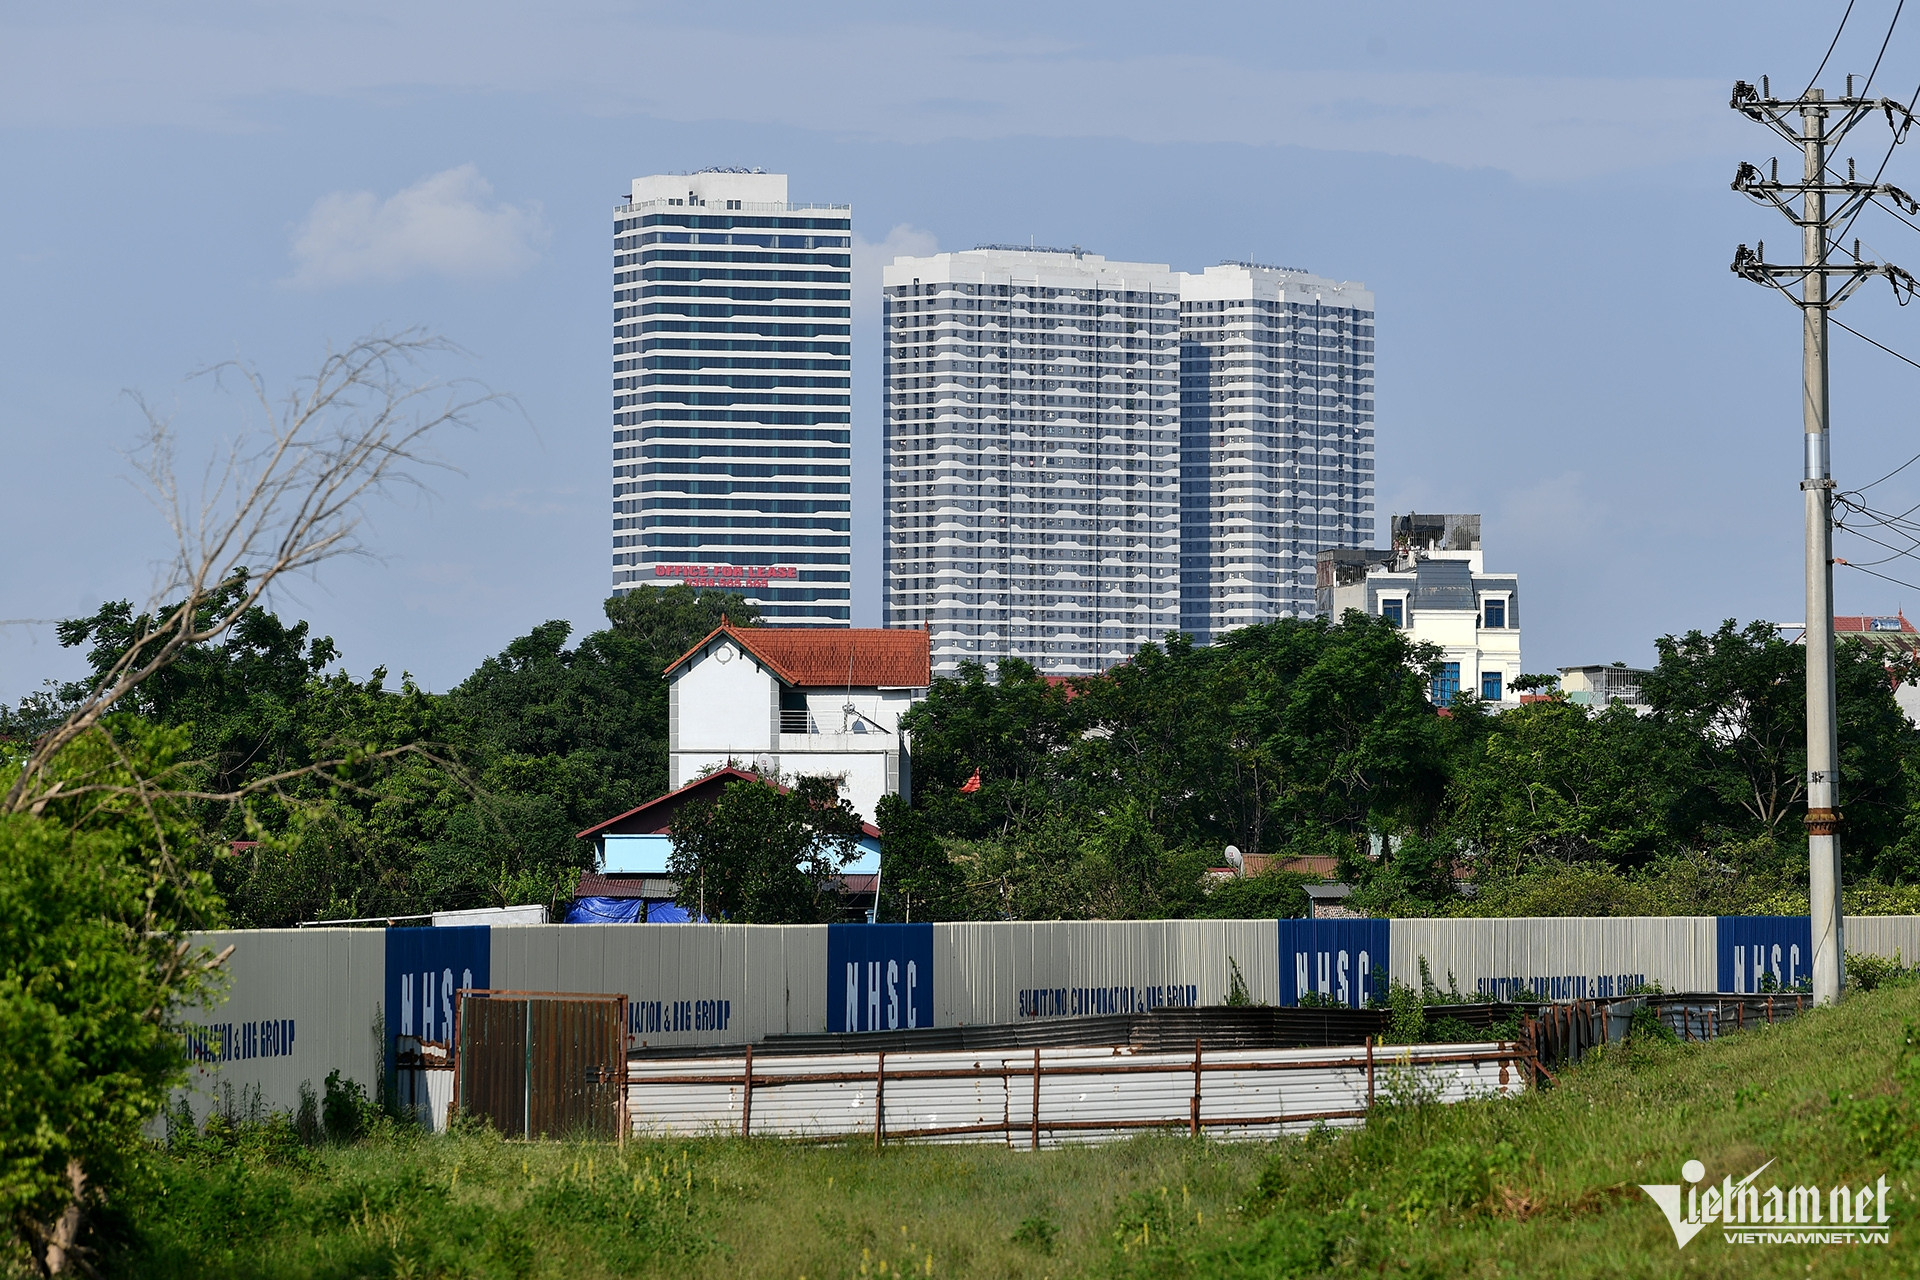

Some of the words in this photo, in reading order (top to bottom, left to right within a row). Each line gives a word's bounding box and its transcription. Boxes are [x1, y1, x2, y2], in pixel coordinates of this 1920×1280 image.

[655, 565, 708, 577] OFFICE
[713, 566, 744, 577] FOR
[748, 567, 797, 578] LEASE
[1296, 949, 1370, 1010] NHSC
[1735, 943, 1800, 994] NHSC
[663, 1005, 671, 1032] &
[695, 999, 731, 1031] GROUP
[846, 959, 917, 1033] NHSC
[1019, 987, 1067, 1018] SUMITOMO
[234, 1027, 241, 1061] &
[260, 1018, 295, 1058] GROUP
